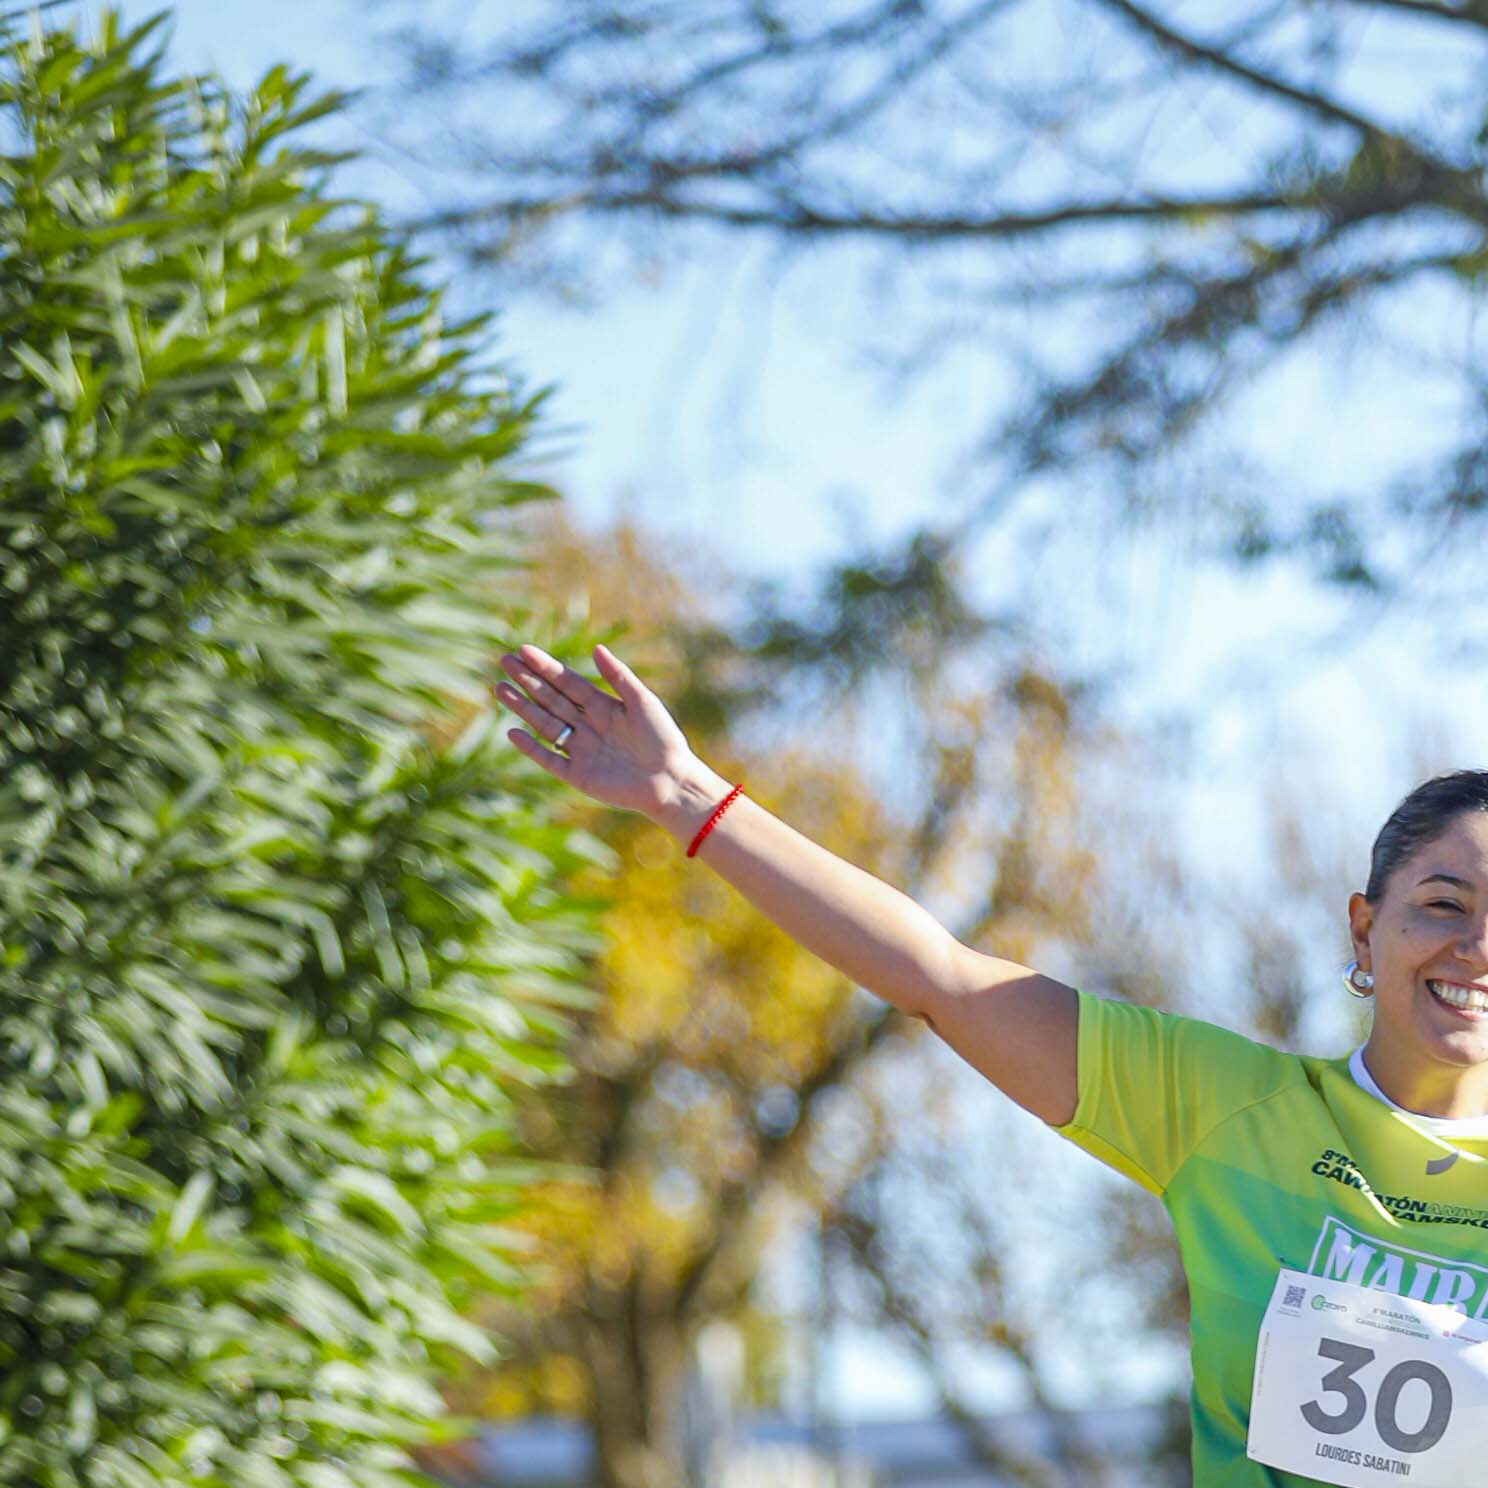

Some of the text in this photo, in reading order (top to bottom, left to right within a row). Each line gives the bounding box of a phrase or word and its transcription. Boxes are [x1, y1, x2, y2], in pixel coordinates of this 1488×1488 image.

[1300, 1337, 1453, 1453] 30
[1315, 1443, 1411, 1476] LOURDES SABATINI
